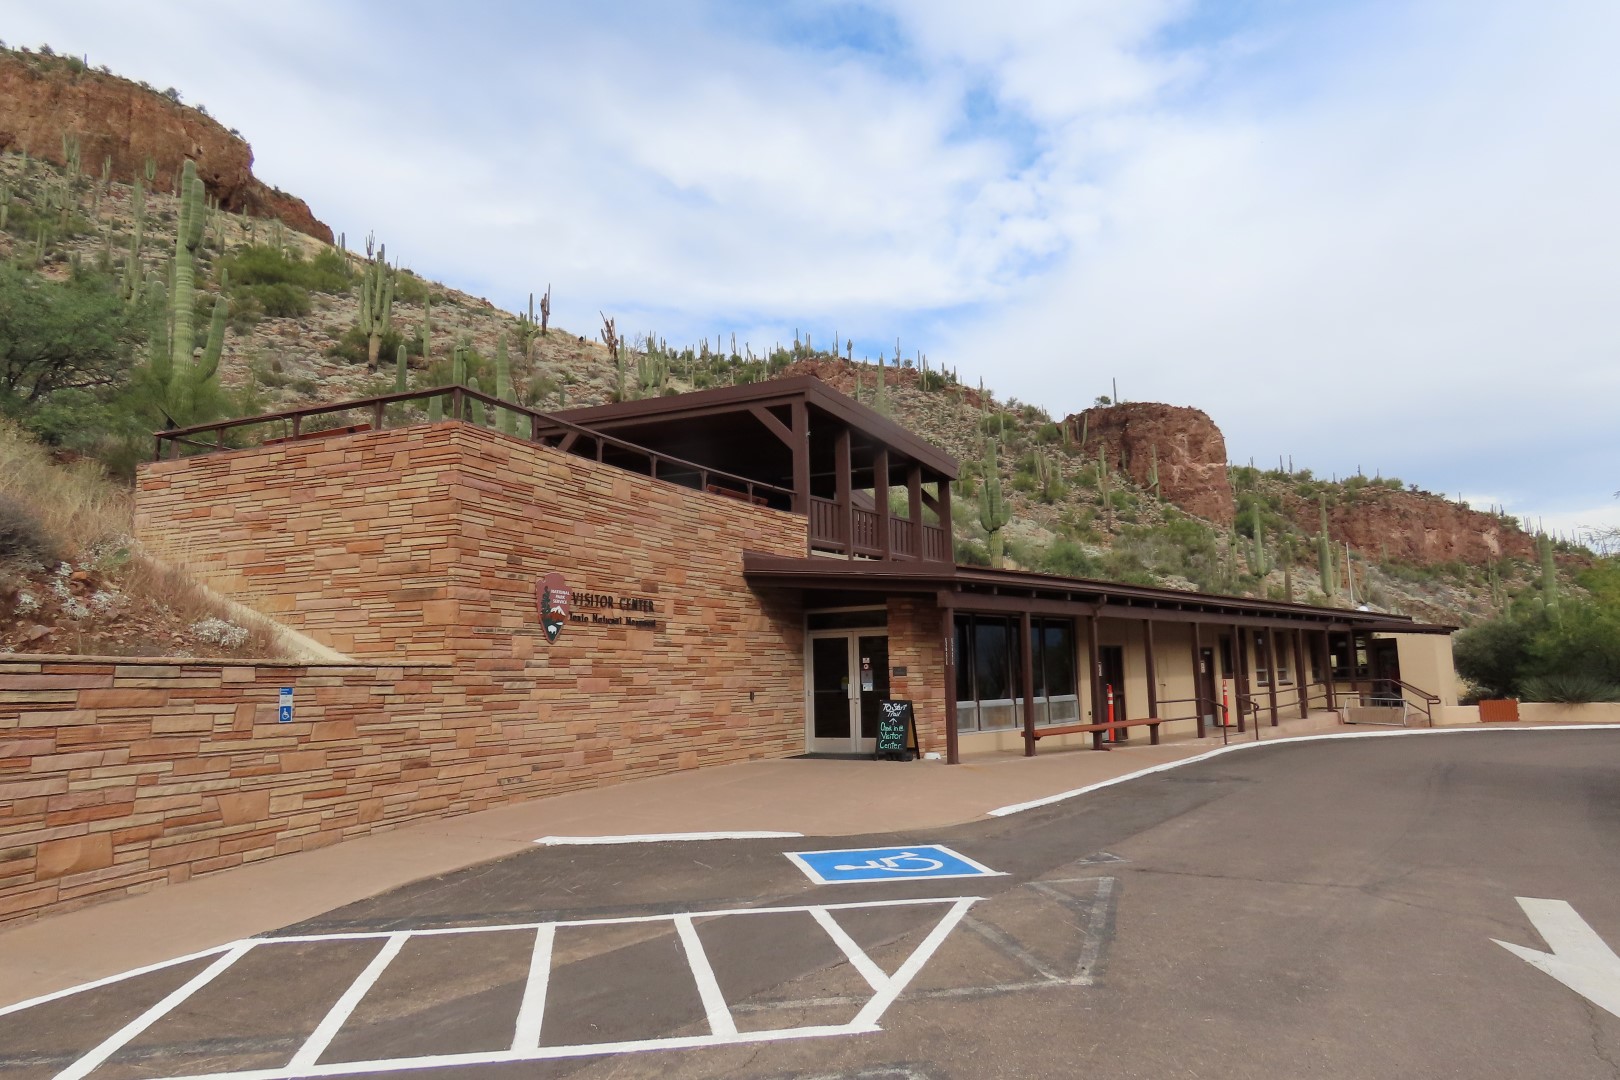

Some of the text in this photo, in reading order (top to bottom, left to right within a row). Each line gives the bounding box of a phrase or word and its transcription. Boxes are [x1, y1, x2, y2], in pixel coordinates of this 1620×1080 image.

[571, 592, 655, 612] VISITOR CENTER
[592, 612, 621, 625] National
[880, 731, 903, 740] Visitor
[879, 739, 902, 749] Center
